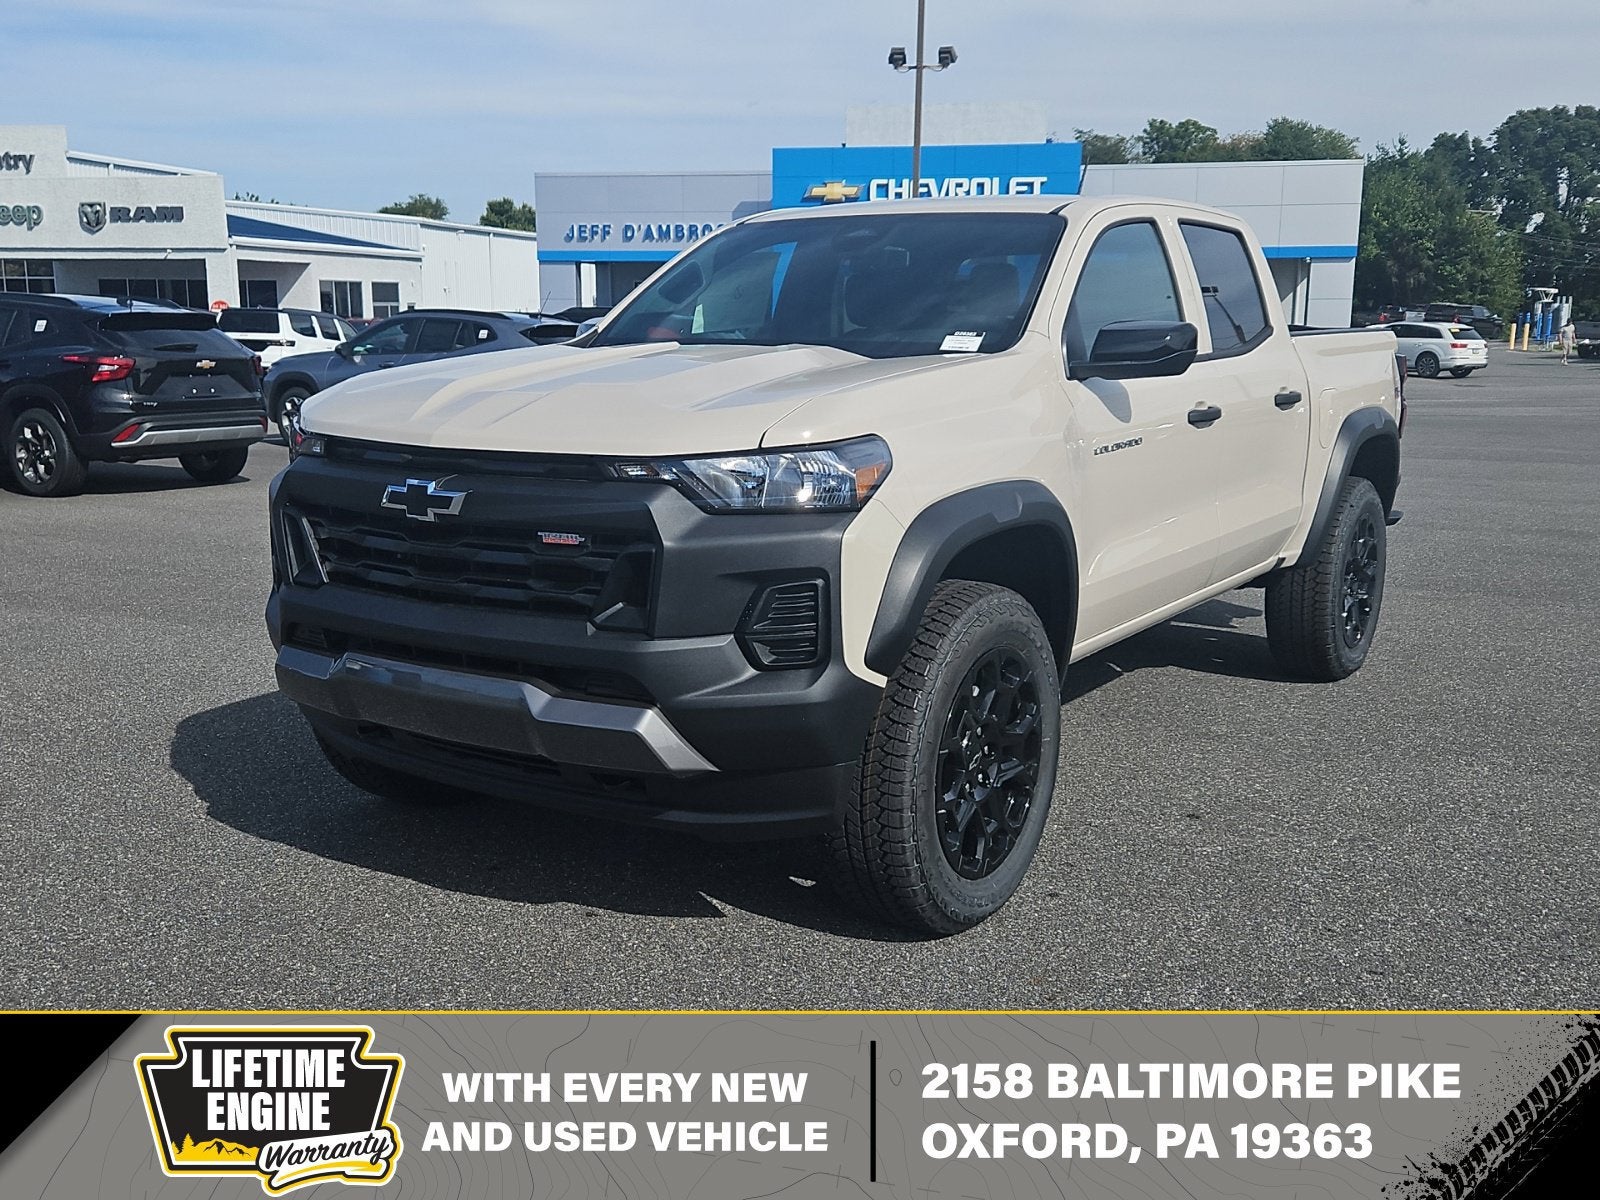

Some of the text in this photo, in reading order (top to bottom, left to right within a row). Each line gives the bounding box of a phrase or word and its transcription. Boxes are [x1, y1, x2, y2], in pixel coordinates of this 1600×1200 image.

[869, 176, 1048, 200] CHEVROLET
[109, 206, 183, 223] RAM
[564, 224, 611, 243] JEFF
[1093, 437, 1143, 456] COLORADO
